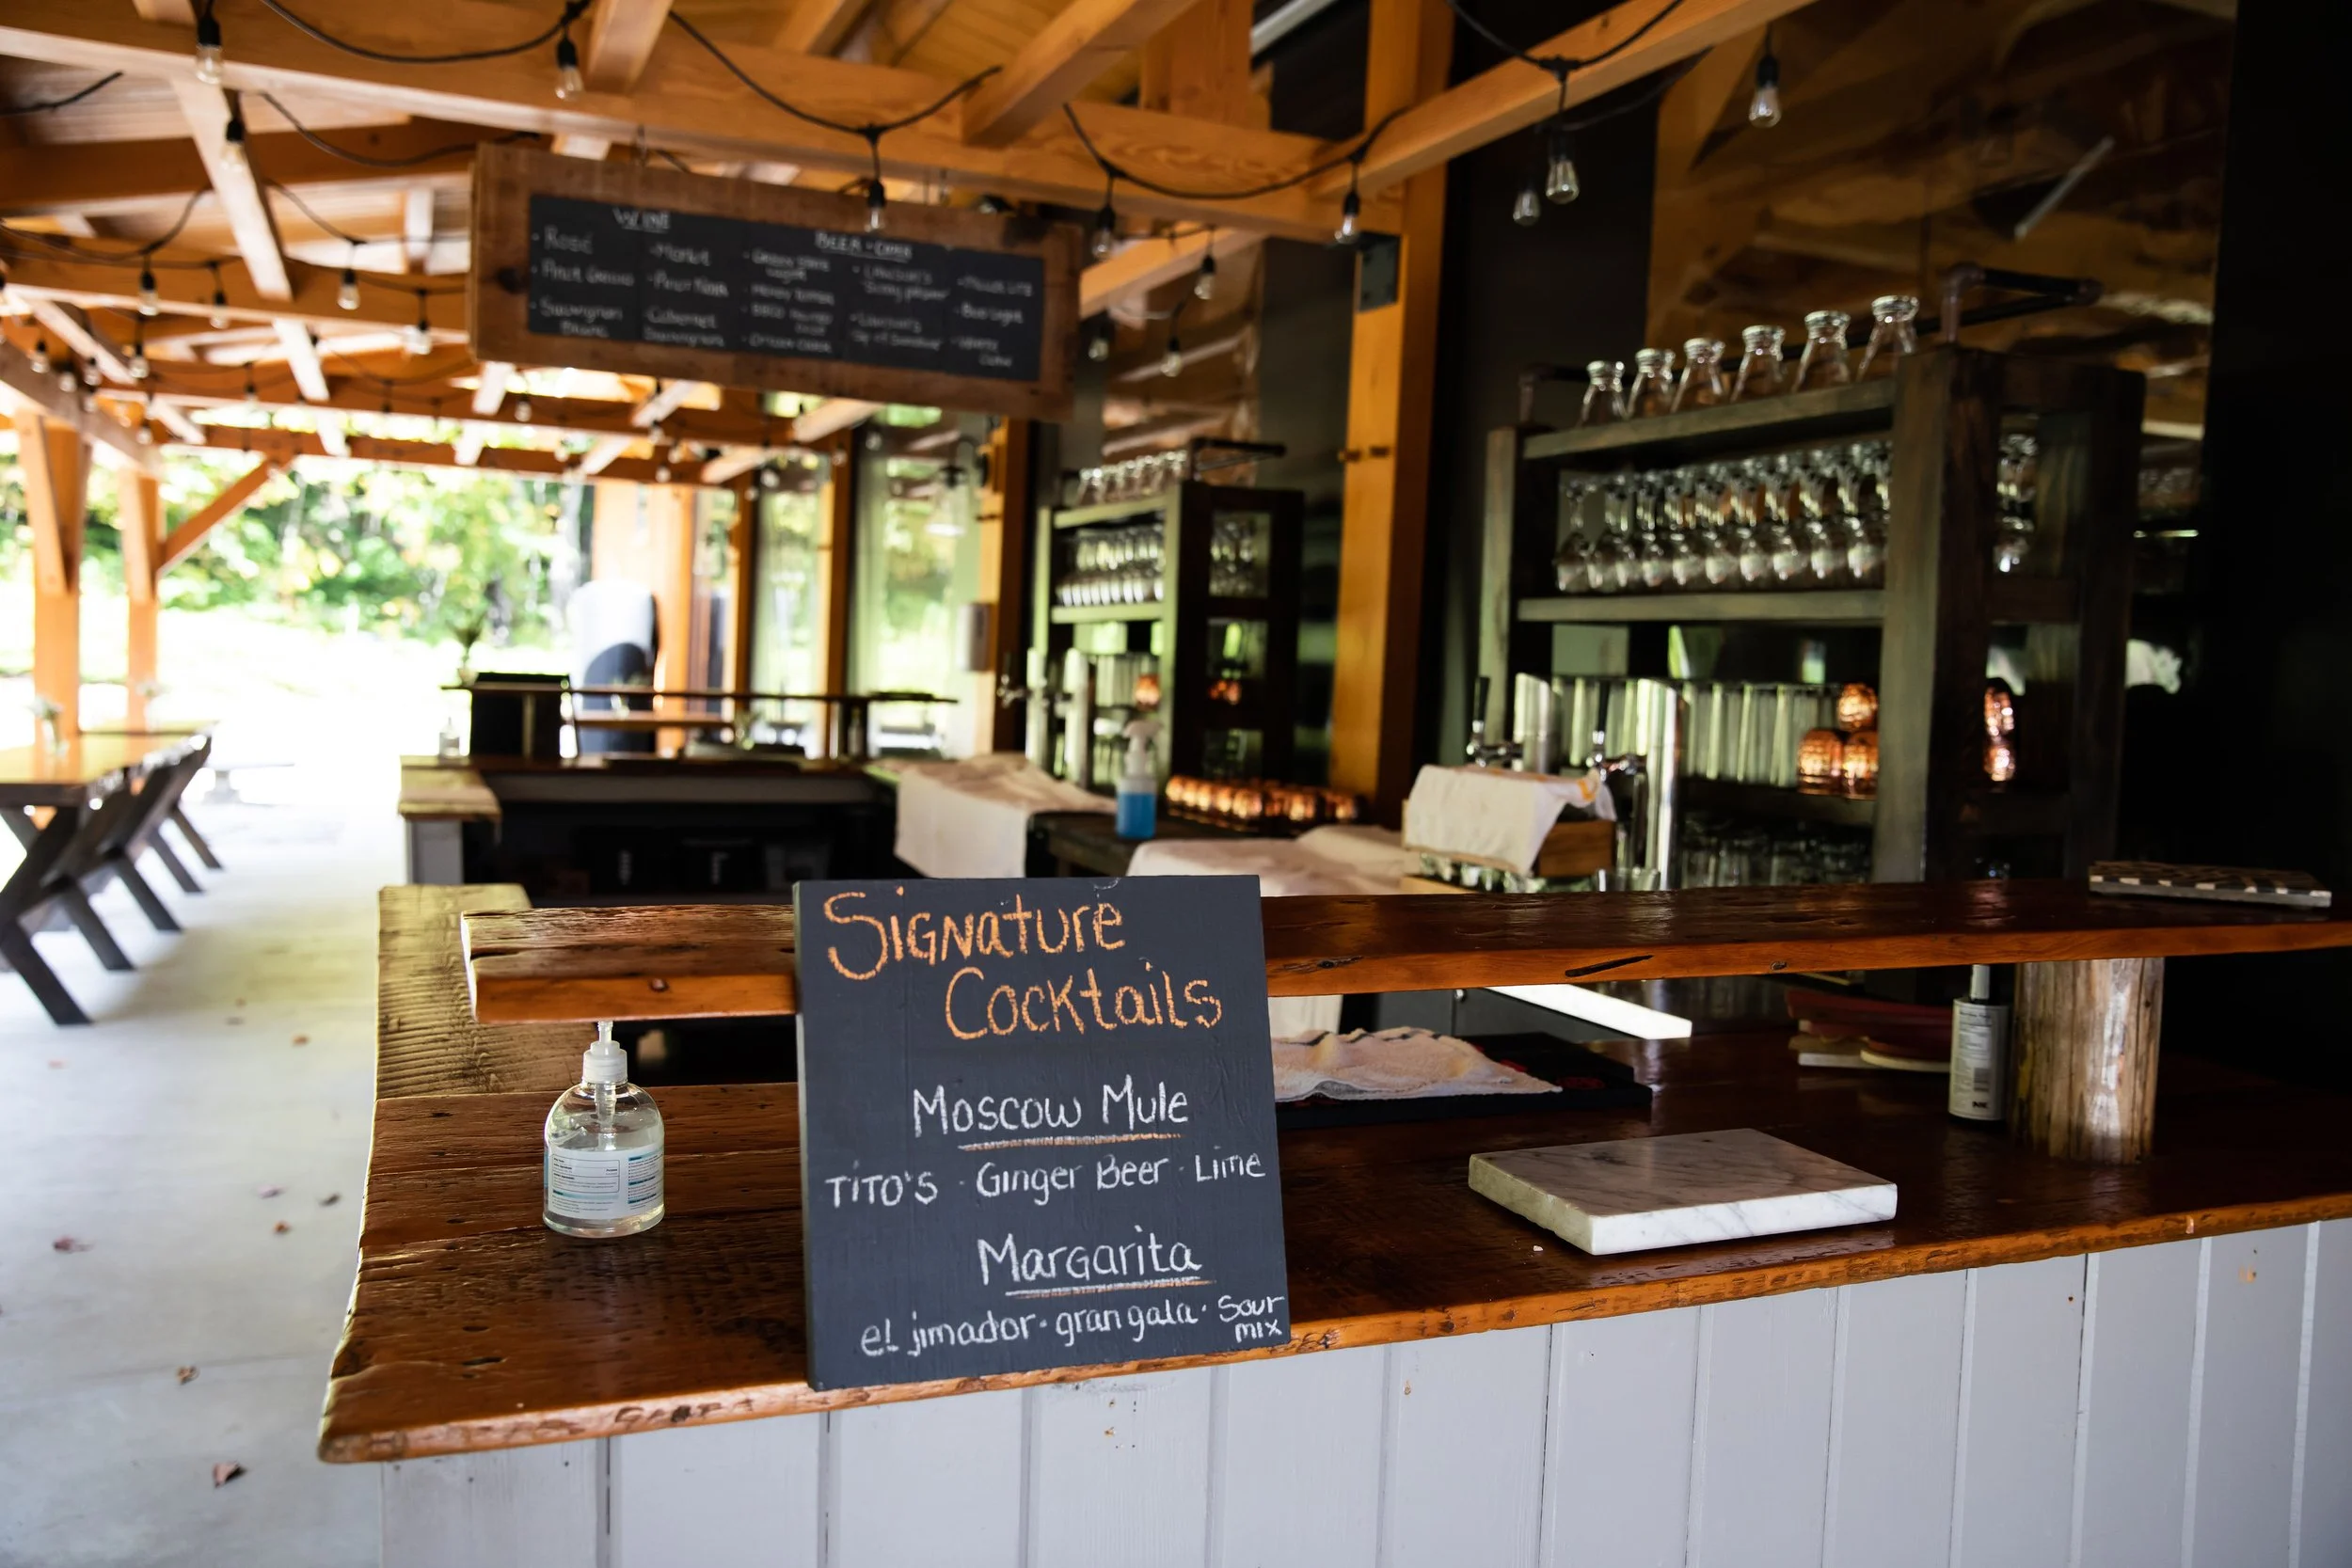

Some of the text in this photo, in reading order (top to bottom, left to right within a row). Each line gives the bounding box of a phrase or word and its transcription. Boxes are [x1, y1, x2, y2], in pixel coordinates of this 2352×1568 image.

[945, 962, 1222, 1040] Cocktails
[913, 1073, 1189, 1140] Moscow Mule
[976, 1163, 1081, 1205] Ginger
[1096, 1154, 1169, 1190] Beer
[1195, 1146, 1266, 1182] Lime
[977, 1225, 1203, 1285] Margarita
[860, 1320, 897, 1356] el
[907, 1310, 1037, 1357] jimador
[1217, 1294, 1285, 1324] Sour
[1234, 1318, 1283, 1343] mix
